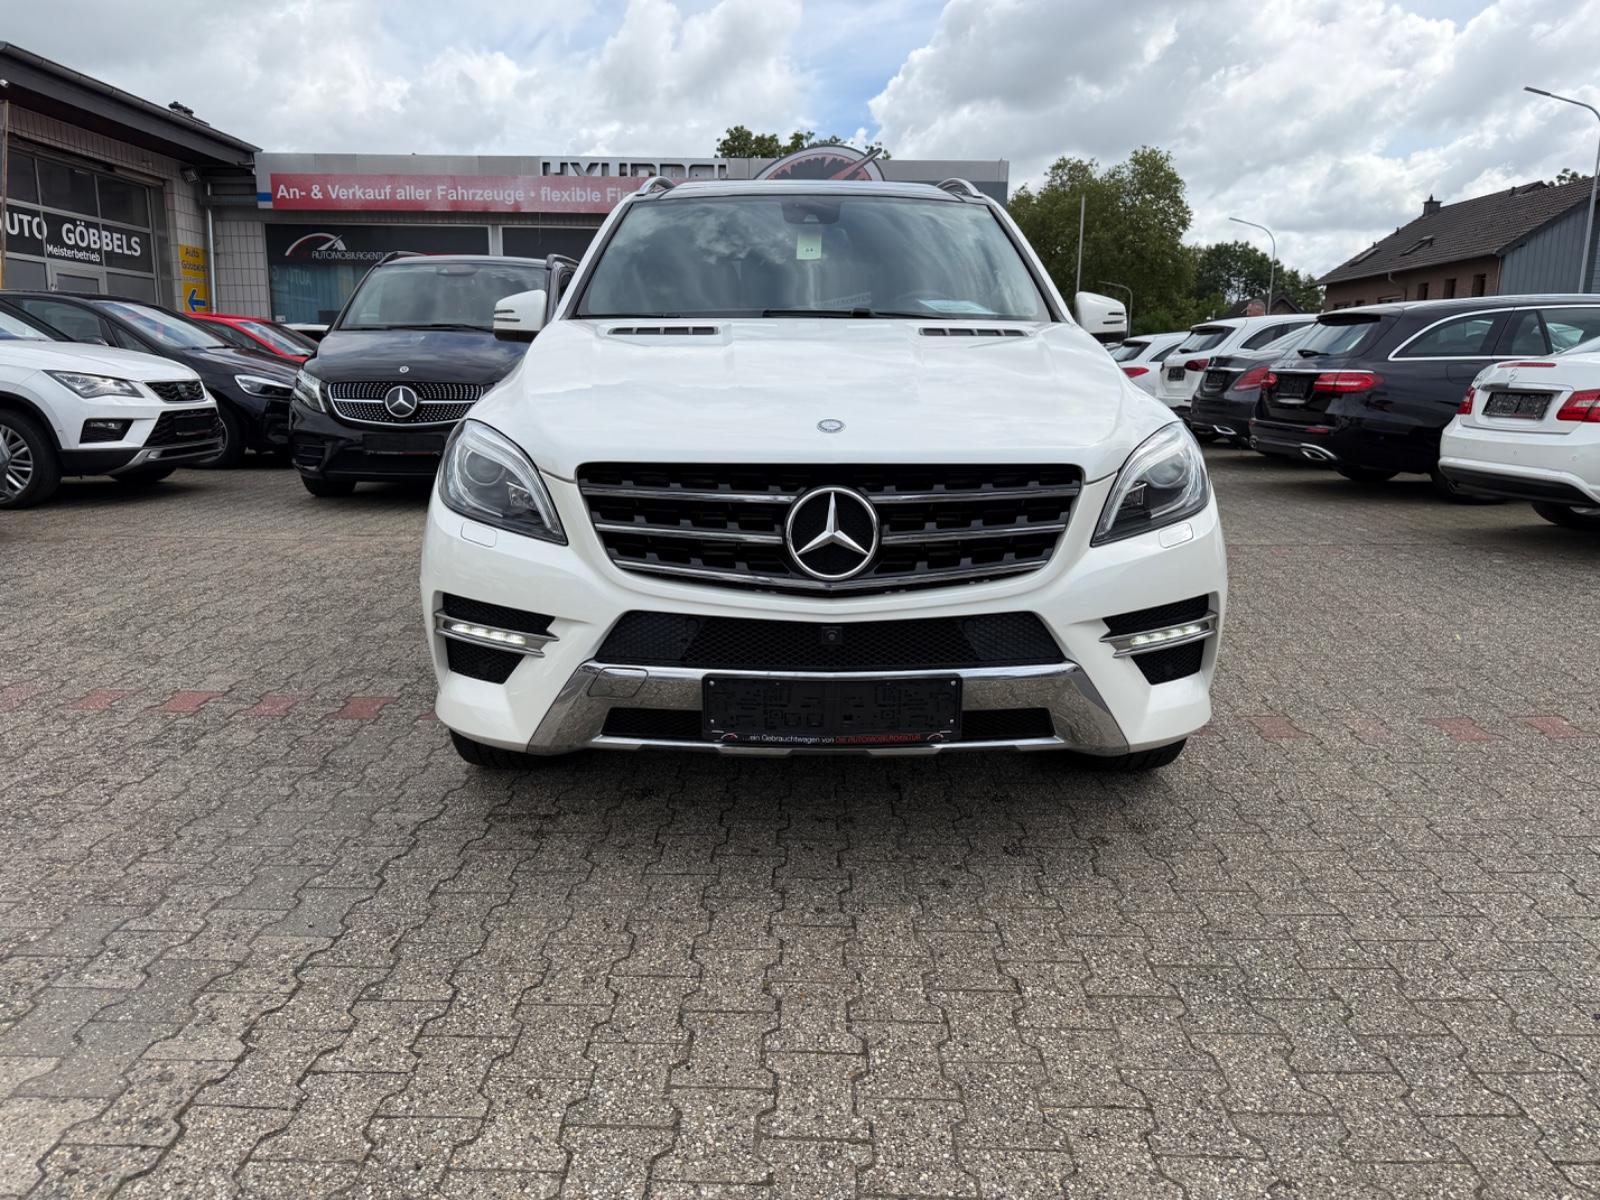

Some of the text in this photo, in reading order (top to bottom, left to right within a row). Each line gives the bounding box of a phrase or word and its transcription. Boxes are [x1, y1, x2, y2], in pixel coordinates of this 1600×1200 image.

[276, 184, 306, 200] An-
[310, 184, 324, 200] &
[327, 184, 391, 200] Verkauf
[395, 185, 432, 201] aller
[437, 185, 524, 205] Fahrzeuge
[540, 186, 601, 202] flexible
[0, 211, 141, 257] UTO GÖBBELS
[46, 242, 101, 262] Meisterbetrieb
[762, 734, 820, 745] Gebrauchtwagen
[821, 736, 834, 744] von
